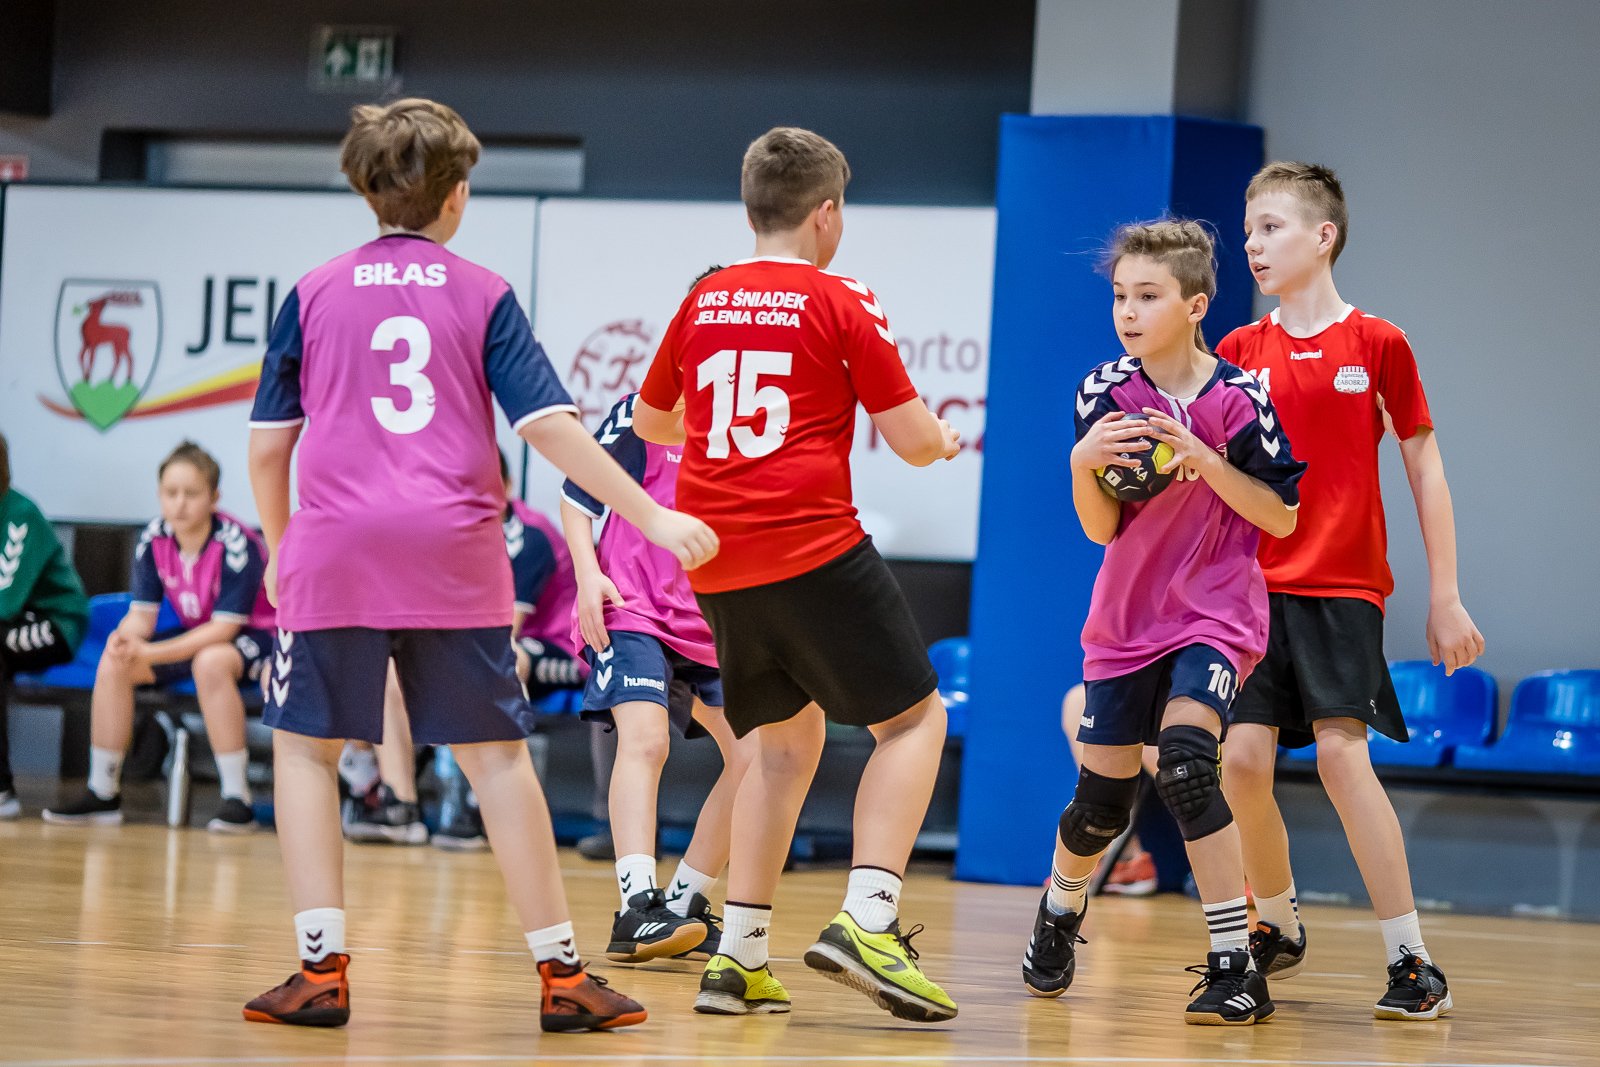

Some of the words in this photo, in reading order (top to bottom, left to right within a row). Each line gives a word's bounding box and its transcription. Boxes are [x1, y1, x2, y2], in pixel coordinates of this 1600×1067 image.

[354, 262, 447, 287] BIŁAS
[698, 291, 729, 308] UKS
[731, 288, 809, 310] ŚNIADEK
[694, 310, 752, 325] JELENIA
[755, 308, 800, 328] GÓRA
[370, 315, 436, 434] 3
[696, 349, 793, 459] 15
[623, 675, 665, 691] hummel
[1207, 663, 1231, 700] 10
